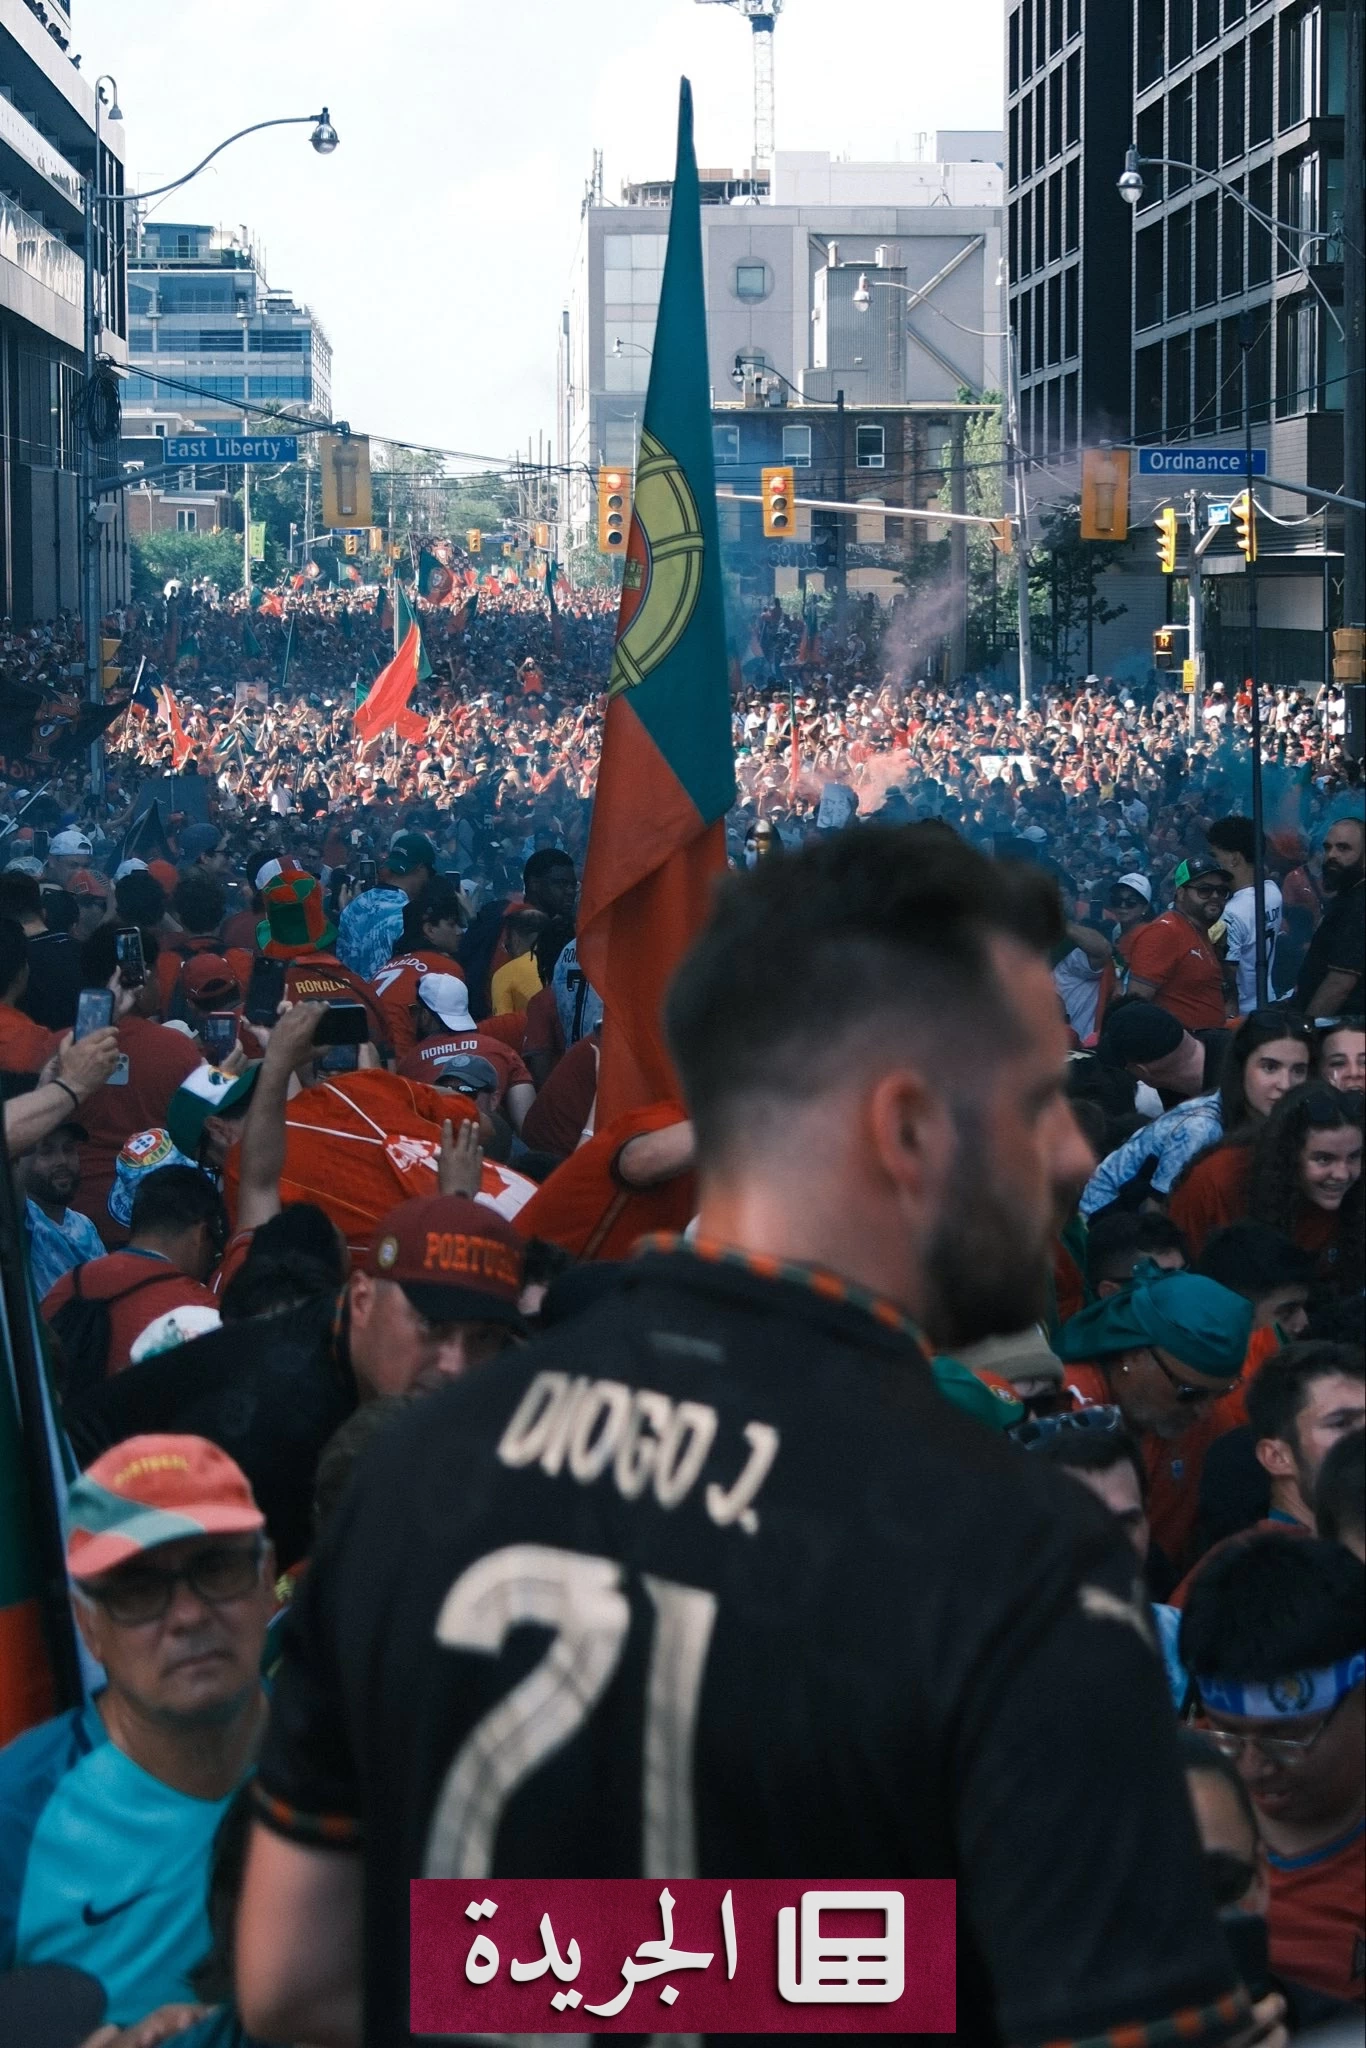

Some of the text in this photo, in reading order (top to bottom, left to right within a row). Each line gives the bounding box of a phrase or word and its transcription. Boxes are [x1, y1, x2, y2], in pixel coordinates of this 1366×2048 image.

[167, 438, 294, 460] East Liberty St
[1150, 452, 1254, 470] Ordnance t
[374, 968, 404, 997] 7
[567, 969, 589, 1042] 7
[421, 1040, 478, 1060] RONALDO
[498, 1370, 718, 1511] DIOGO
[422, 1543, 718, 1879] 21
